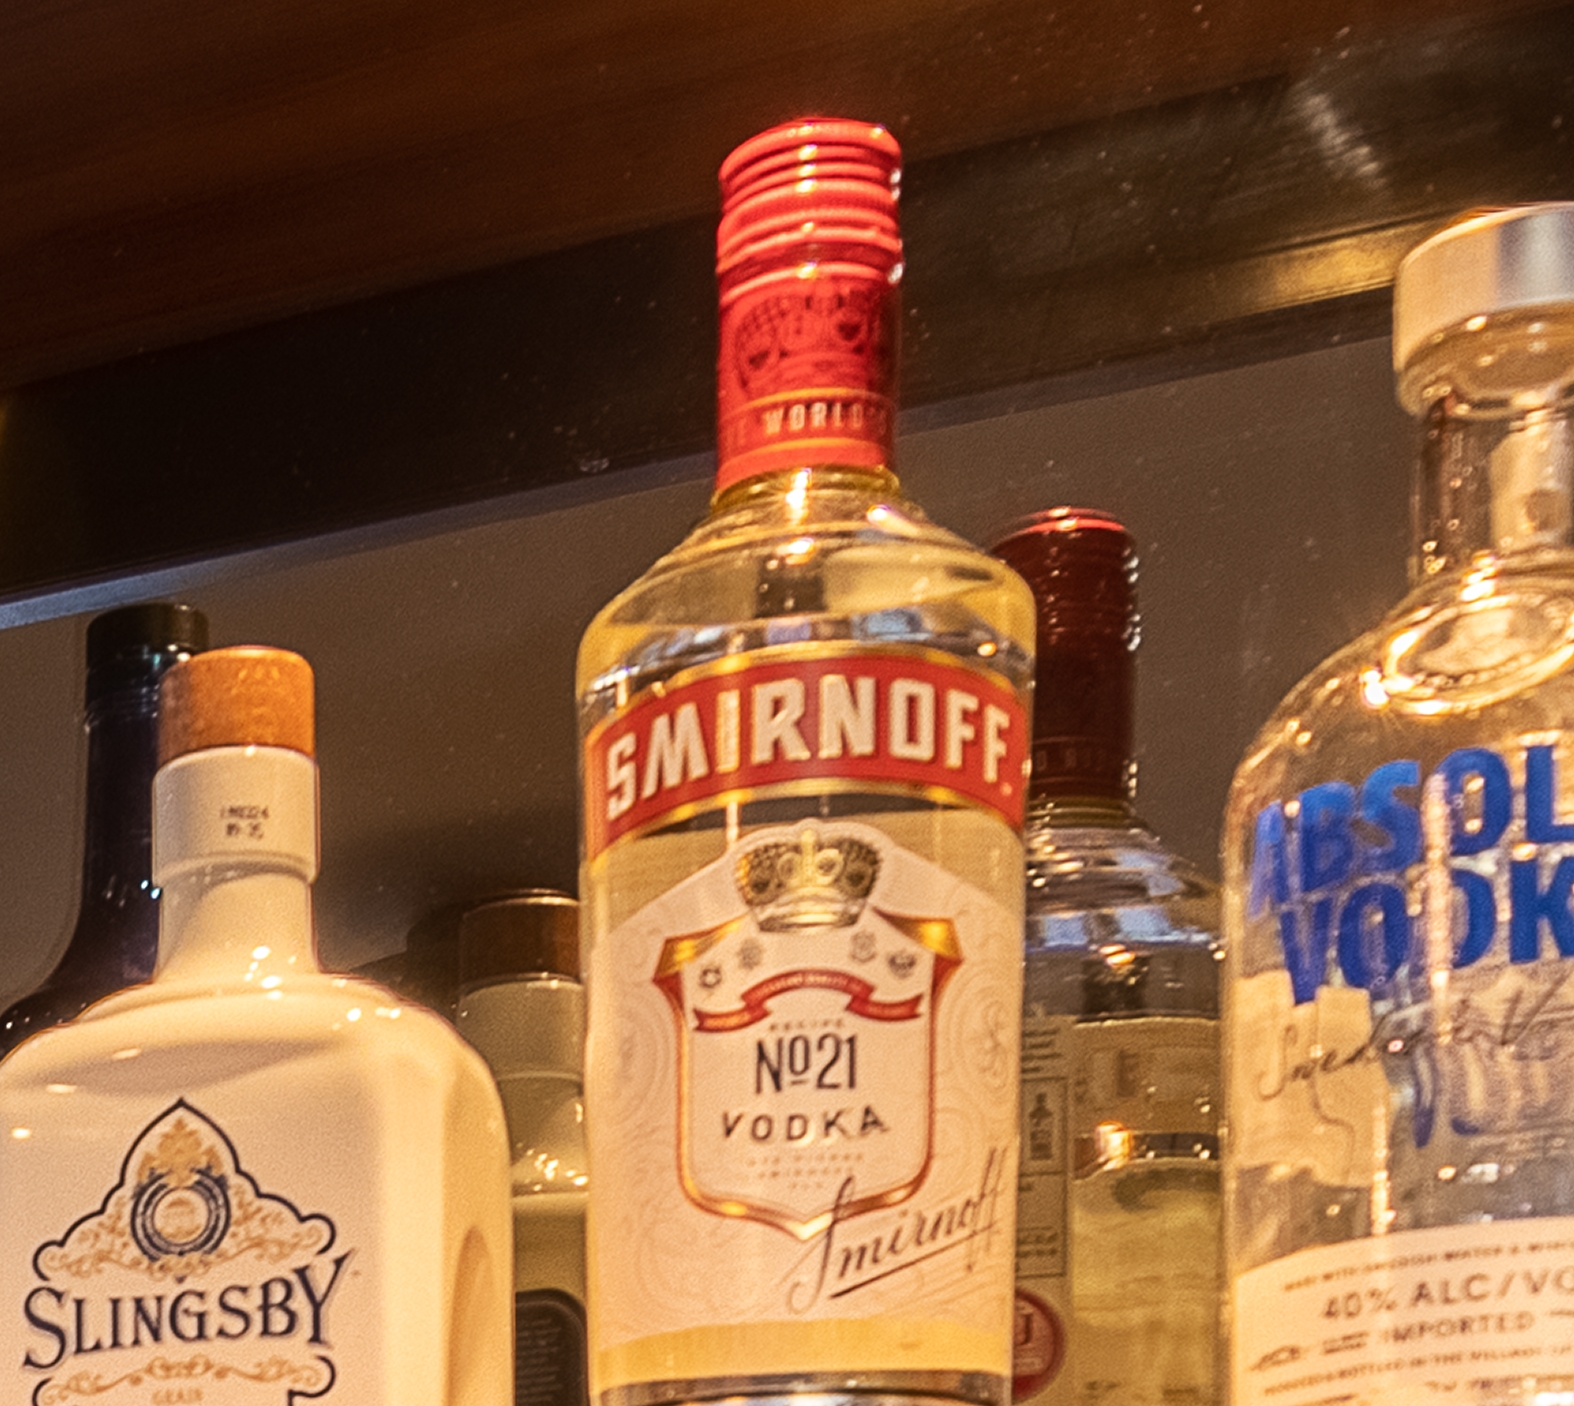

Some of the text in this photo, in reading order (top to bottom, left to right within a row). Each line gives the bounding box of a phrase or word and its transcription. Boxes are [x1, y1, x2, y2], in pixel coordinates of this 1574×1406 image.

[605, 673, 1011, 822] SMIRNOFF
[722, 1105, 891, 1143] VODKA
[782, 1147, 1009, 1314] Smirnoff
[20, 1248, 359, 1372] SLINGSBY
[1322, 1286, 1399, 1319] 40%
